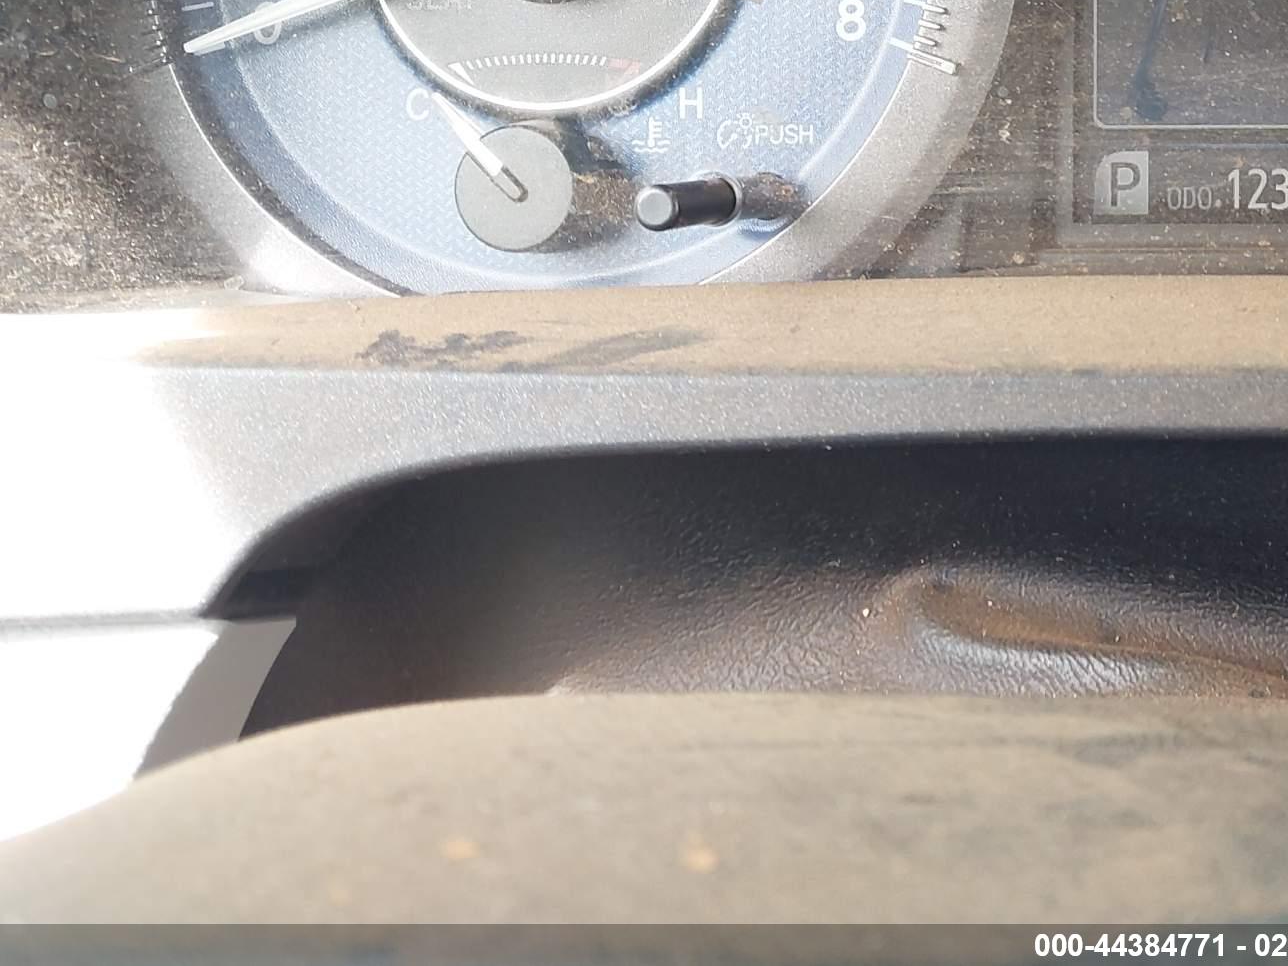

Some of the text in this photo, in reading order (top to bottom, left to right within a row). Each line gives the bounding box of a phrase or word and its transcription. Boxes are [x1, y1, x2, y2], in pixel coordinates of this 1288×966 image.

[406, 88, 432, 121] C
[679, 87, 704, 119] H
[756, 124, 814, 146] PUSH
[1110, 162, 1141, 208] P
